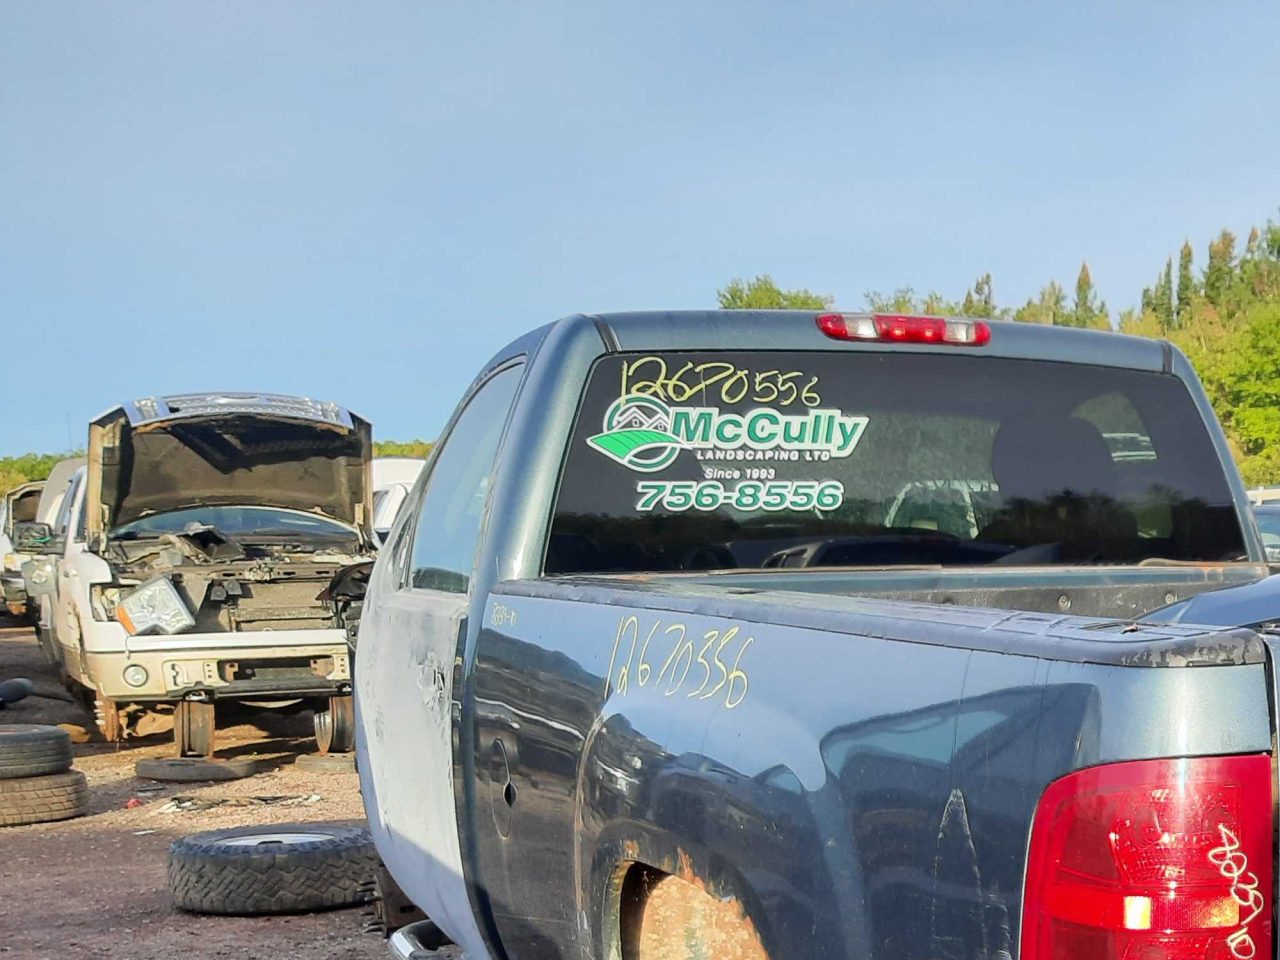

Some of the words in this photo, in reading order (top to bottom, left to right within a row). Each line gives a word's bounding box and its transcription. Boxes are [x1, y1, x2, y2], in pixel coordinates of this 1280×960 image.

[670, 407, 869, 457] McCully
[696, 450, 799, 461] LANDSCAPING
[704, 468, 741, 479] Since
[746, 468, 776, 479] 1993
[636, 480, 845, 512] 756-8556
